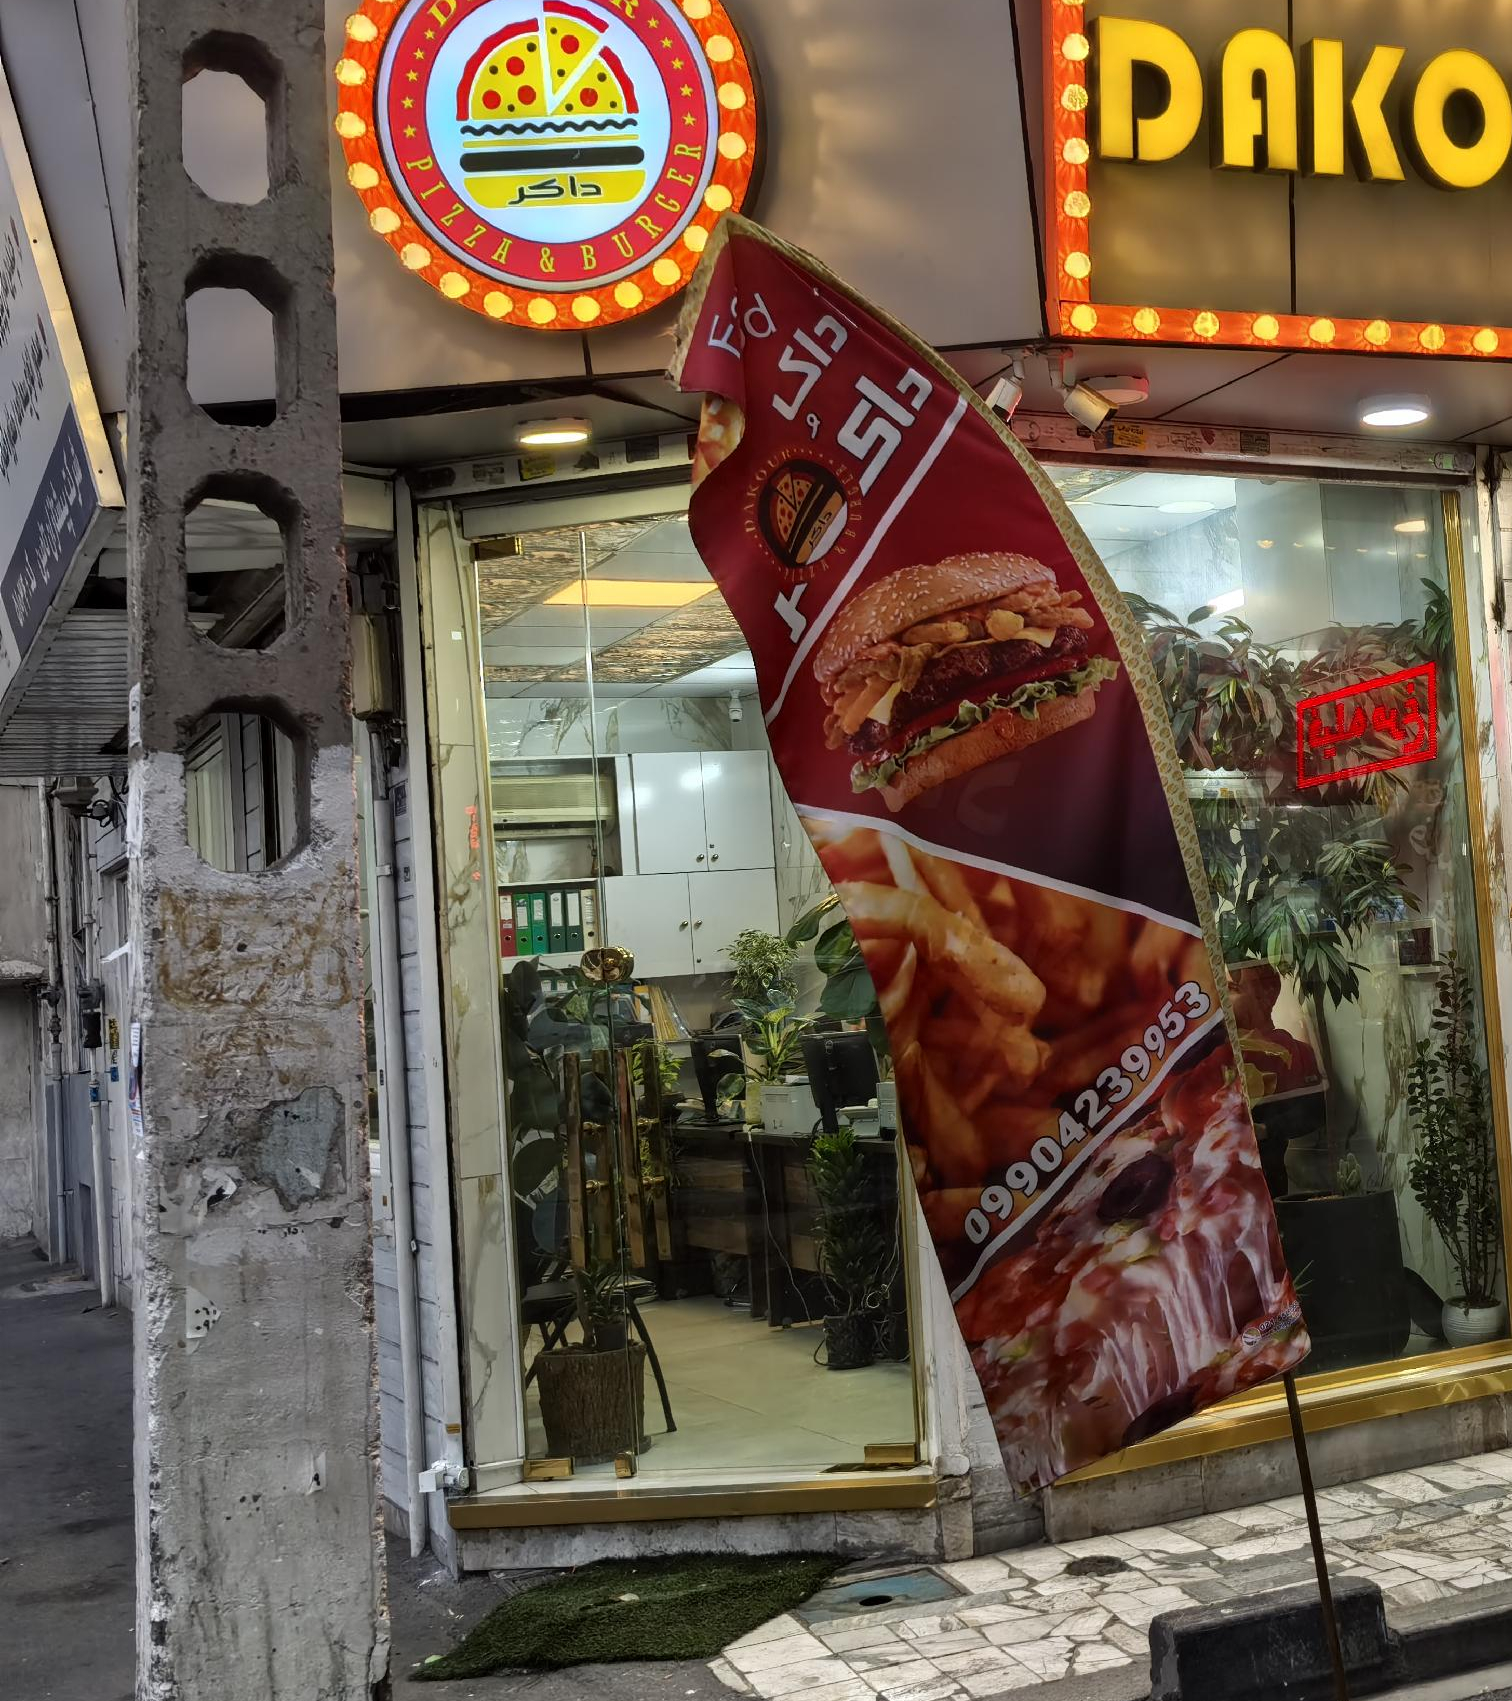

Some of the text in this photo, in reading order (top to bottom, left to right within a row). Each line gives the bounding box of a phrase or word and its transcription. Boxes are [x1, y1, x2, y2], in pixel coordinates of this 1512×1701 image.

[405, 142, 702, 274] PIZZA & BURGER
[507, 174, 602, 207] داکر
[963, 980, 1211, 1245] 09904239953
